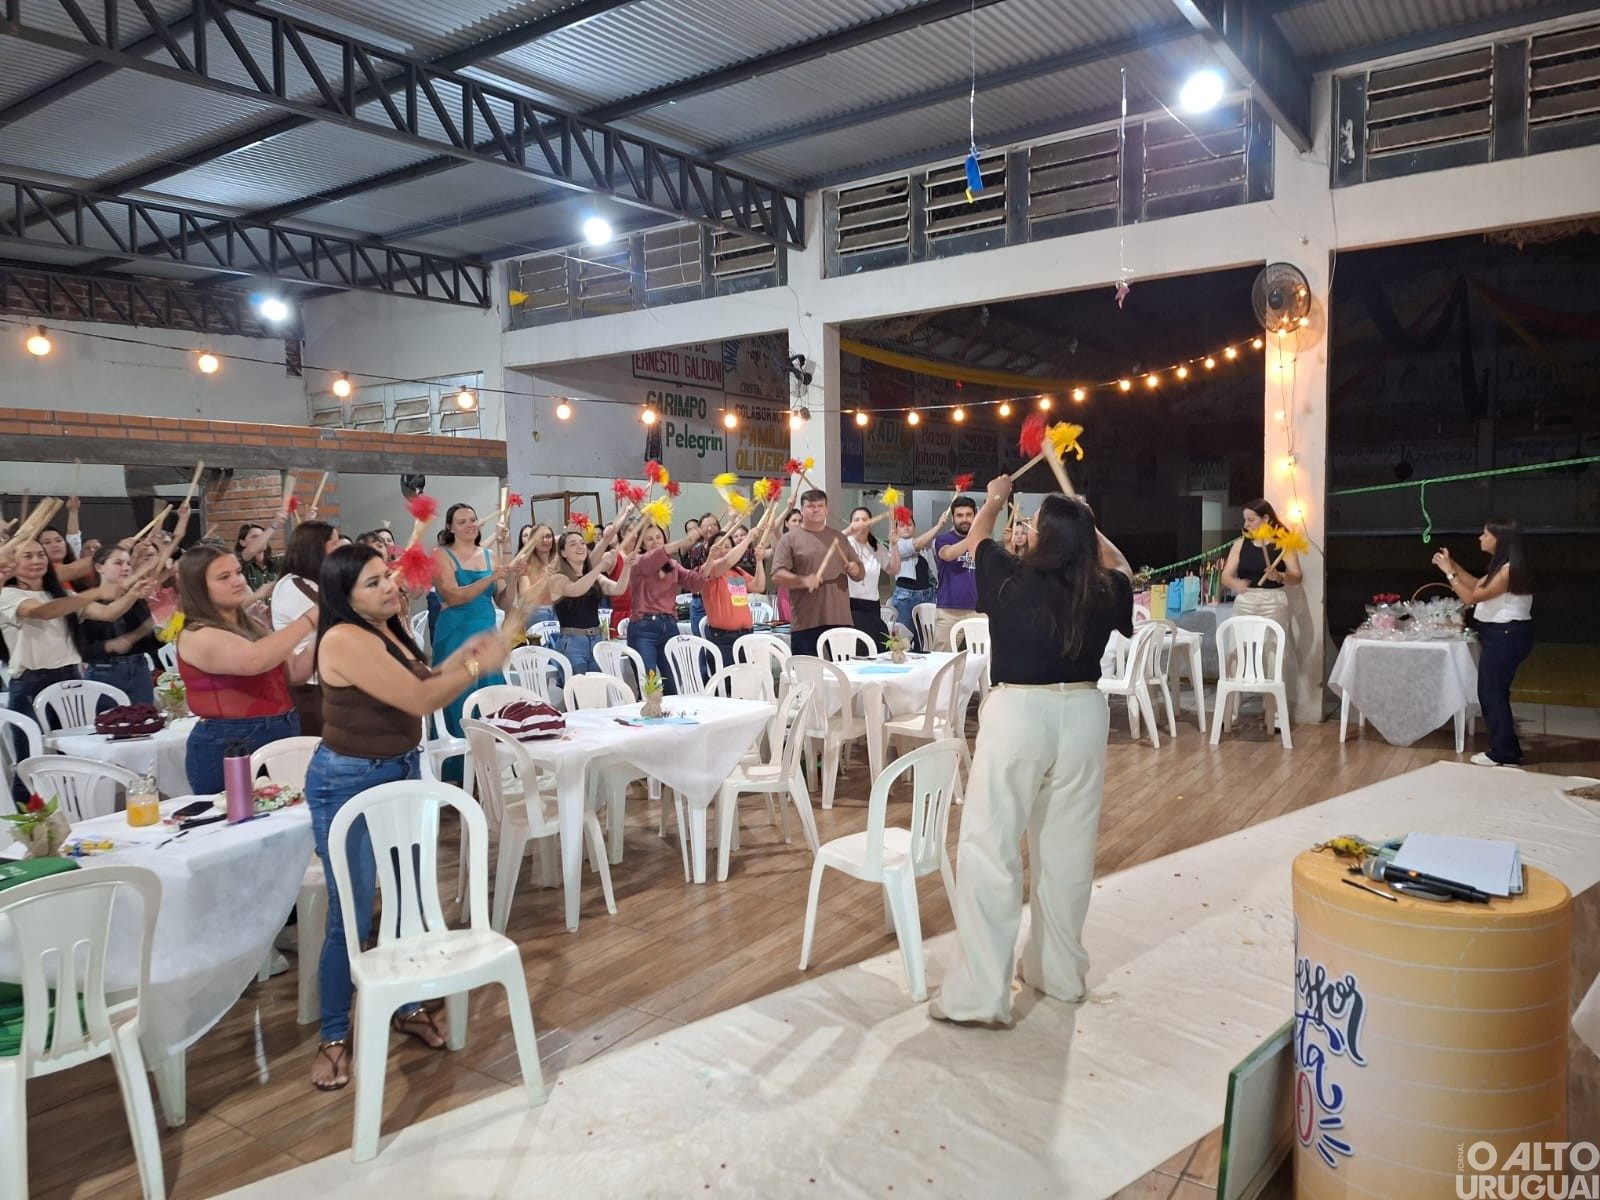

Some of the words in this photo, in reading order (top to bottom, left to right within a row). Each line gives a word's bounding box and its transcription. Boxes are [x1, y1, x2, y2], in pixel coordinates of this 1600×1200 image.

[635, 350, 680, 376] ERNESTO
[684, 355, 722, 383] GALDONI
[646, 390, 707, 420] GARIMPO
[665, 421, 723, 458] Pelegrin
[735, 448, 789, 473] OLIVEIR
